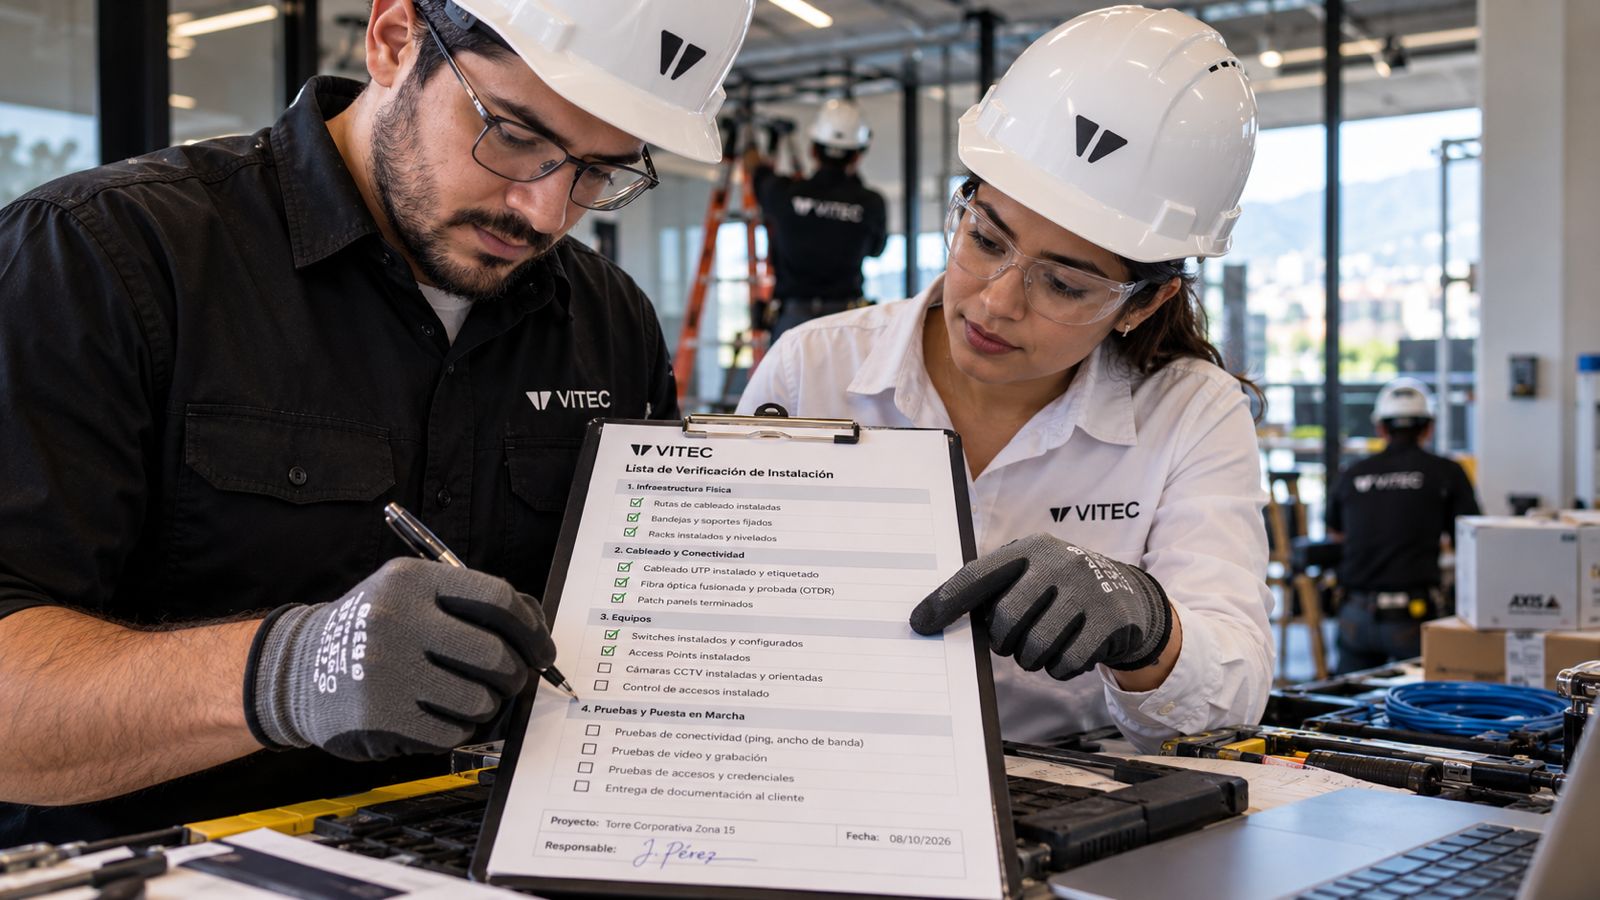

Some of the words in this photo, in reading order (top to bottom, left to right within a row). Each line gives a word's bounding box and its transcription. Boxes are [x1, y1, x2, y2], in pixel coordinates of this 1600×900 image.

[556, 390, 611, 408] VITEC
[656, 445, 713, 459] VITEC
[625, 464, 654, 473] Lista
[656, 465, 673, 474] de
[675, 465, 746, 476] Verificación
[749, 468, 765, 477] de
[768, 468, 834, 479] Instalación
[636, 483, 704, 493] Infraestructura
[653, 499, 679, 508] Rutas
[693, 502, 735, 510] cableado
[736, 503, 781, 511] instaladas
[1075, 501, 1140, 521] VITEC
[651, 514, 692, 525] Bandejas
[693, 518, 700, 526] y
[700, 518, 741, 526] soportes
[742, 518, 773, 528] fijados
[648, 530, 676, 539] Racks
[677, 531, 724, 540] instalados
[733, 533, 777, 542] nivelados
[614, 546, 623, 554] 2.
[625, 547, 672, 556] Cableado
[673, 550, 680, 558] y
[681, 549, 745, 559] Conectividad
[643, 564, 689, 574] Cableado
[690, 566, 711, 574] UTP
[712, 567, 757, 576] instalado
[766, 569, 820, 579] etiquetado
[640, 580, 665, 589] Fibra
[666, 581, 697, 590] óptica
[699, 582, 746, 592] fusionada
[748, 586, 755, 594] y
[756, 585, 797, 594] probada
[799, 586, 835, 596] (OTDR)
[637, 596, 664, 604] Patch
[666, 598, 698, 606] panels
[699, 599, 754, 609] terminados
[1508, 594, 1544, 608] AXIS
[599, 613, 609, 621] 3.
[611, 613, 652, 624] Equipos
[631, 632, 676, 642] Switches
[677, 634, 728, 645] instalados
[729, 638, 736, 647] y
[738, 638, 804, 648] configurados
[628, 648, 664, 658] Access
[666, 650, 698, 660] Points
[699, 651, 751, 662] instalados
[625, 665, 671, 675] Cámaras
[673, 667, 704, 677] CCTV
[705, 669, 758, 680] instaladas
[759, 673, 766, 681] y
[768, 672, 823, 683] orientadas
[622, 682, 661, 692] Control
[662, 684, 677, 694] de
[678, 687, 720, 696] accesos
[722, 688, 770, 698] instalado
[580, 704, 591, 713] 4.
[594, 705, 638, 715] Pruebas
[640, 709, 647, 718] y
[649, 708, 686, 718] Puesta
[688, 711, 702, 719] en
[704, 711, 745, 721] Marcha
[614, 727, 657, 738] Pruebas
[659, 729, 673, 739] de
[675, 732, 742, 742] conectividad
[744, 734, 774, 746] (ping,
[776, 736, 809, 745] ancho
[811, 736, 825, 746] de
[827, 737, 864, 749] banda)
[611, 746, 655, 758] Pruebas
[656, 749, 671, 758] de
[673, 750, 703, 760] video
[705, 753, 712, 762] y
[714, 752, 768, 762] grabación
[608, 765, 652, 776] Pruebas
[654, 768, 669, 777] de
[671, 770, 715, 779] accesos
[718, 773, 724, 781] y
[726, 772, 795, 783] credenciales
[605, 783, 648, 796] Entrega
[650, 786, 665, 796] de
[666, 787, 752, 800] documentación
[755, 791, 765, 801] al
[767, 792, 805, 802] cliente
[550, 816, 599, 828] Proyecto:
[605, 819, 632, 830] Torre
[633, 821, 693, 833] Corporativa
[694, 824, 721, 834] Zona
[723, 825, 736, 835] 15
[846, 831, 880, 842] Fecha:
[889, 834, 952, 846] 08/10/2026
[544, 840, 616, 854] Responsable:
[660, 841, 757, 869] Pérez
